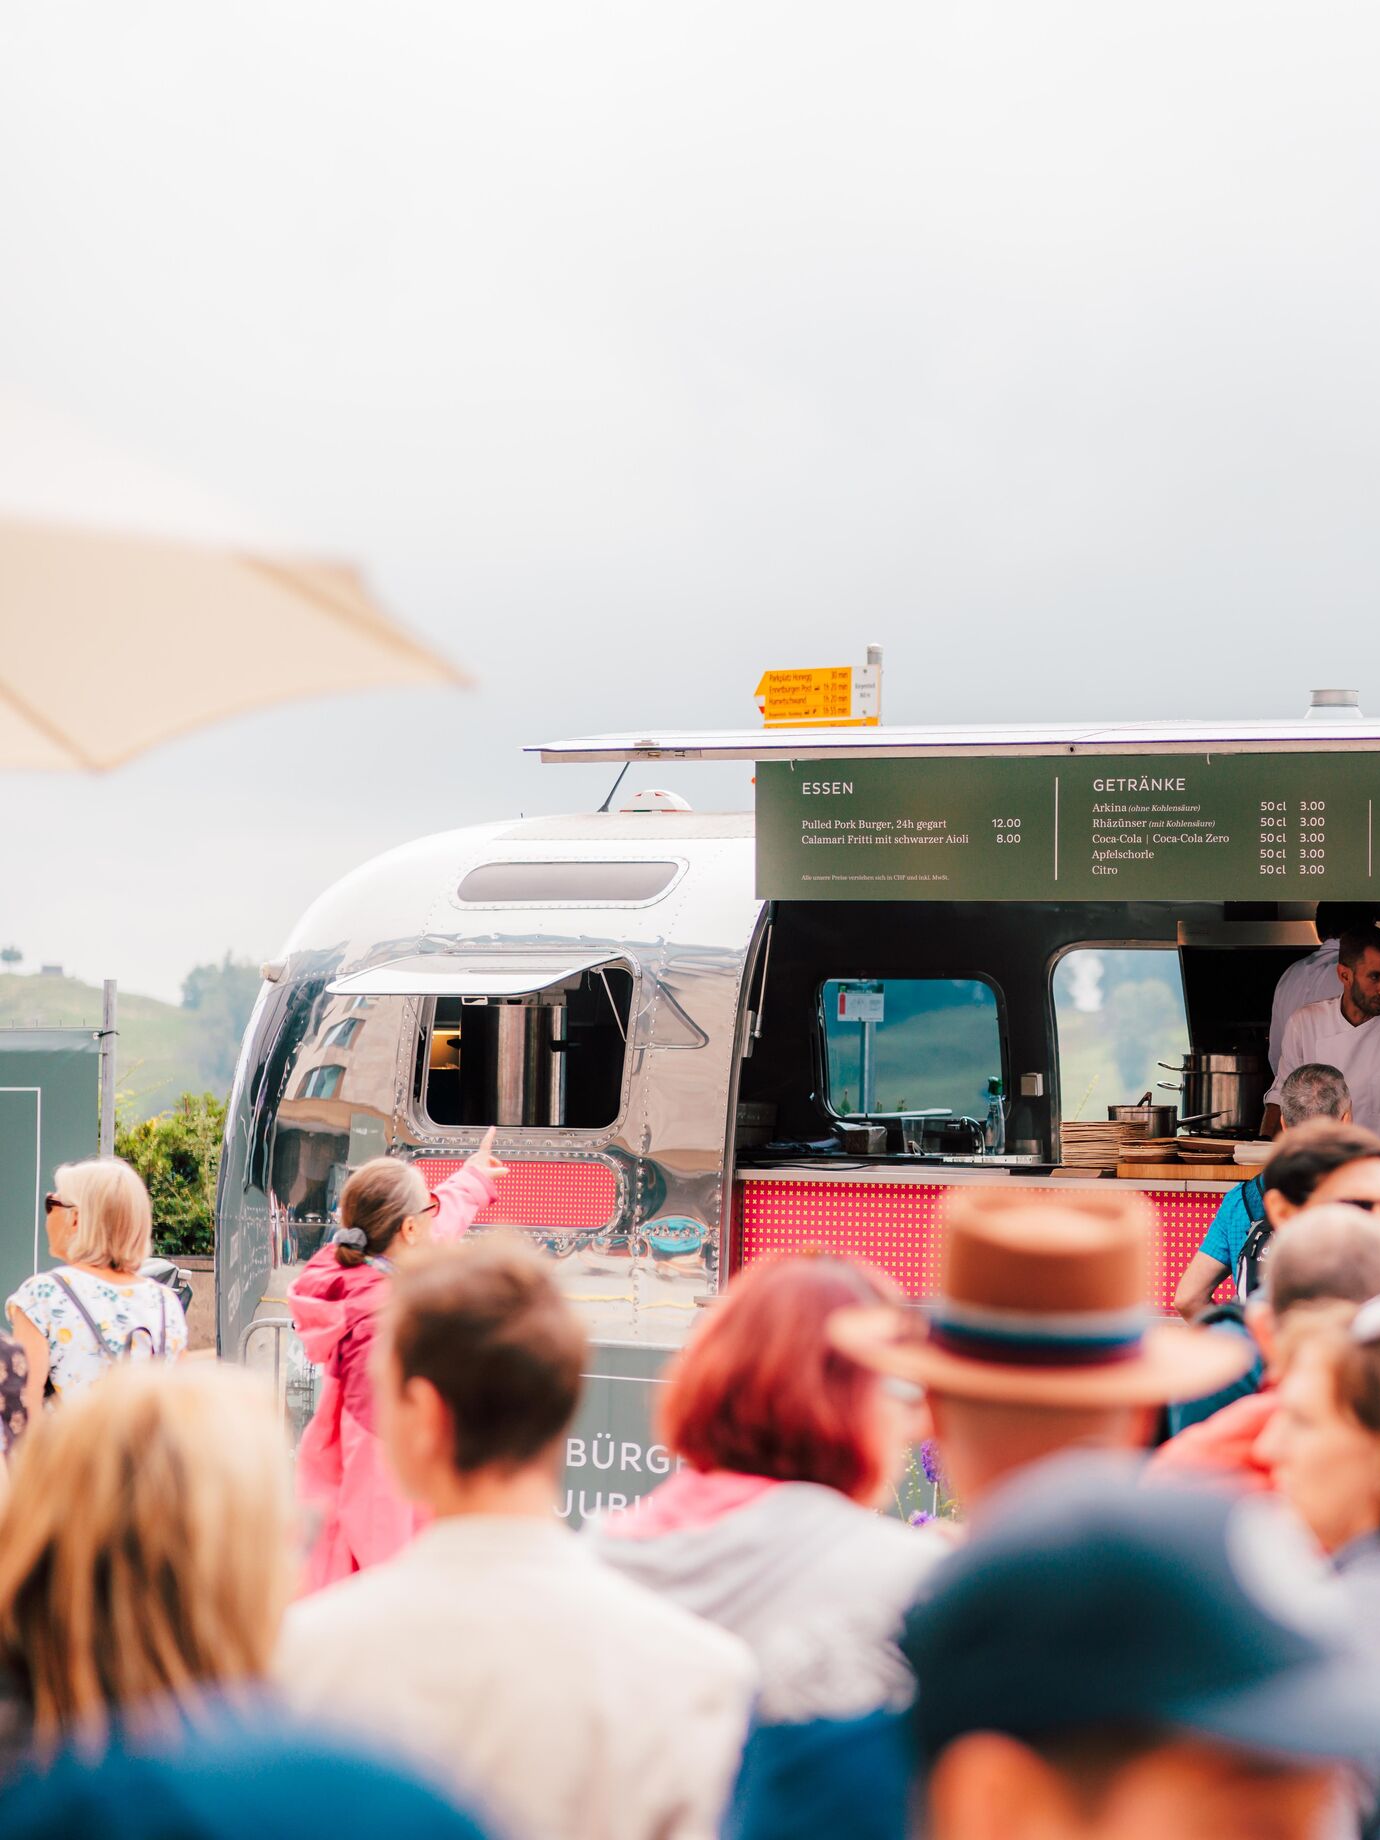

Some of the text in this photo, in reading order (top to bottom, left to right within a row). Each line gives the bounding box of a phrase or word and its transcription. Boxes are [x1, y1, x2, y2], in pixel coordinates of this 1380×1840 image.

[802, 781, 853, 795] ESSEN
[1093, 775, 1186, 792] GETRÄNKE
[1092, 801, 1326, 814] Arkina (ohne Kohlensäure) 50 cl 3.00
[801, 818, 1021, 832] Pulled Pork Burger, 24h gegart 12.00
[1092, 816, 1326, 829] Rhäzünser (mit Kohlensäure) 50 cl 3.00
[801, 833, 1021, 845] Calamari Fritti mit schwarzer Aioli 8.00
[1092, 832, 1325, 844] Coca-Cola Coca-Cola Zero 50 cl 3.00
[1091, 848, 1325, 862] Apfelschorle 50 cl 3.00
[1091, 864, 1325, 875] Citro 50 cl 3.00
